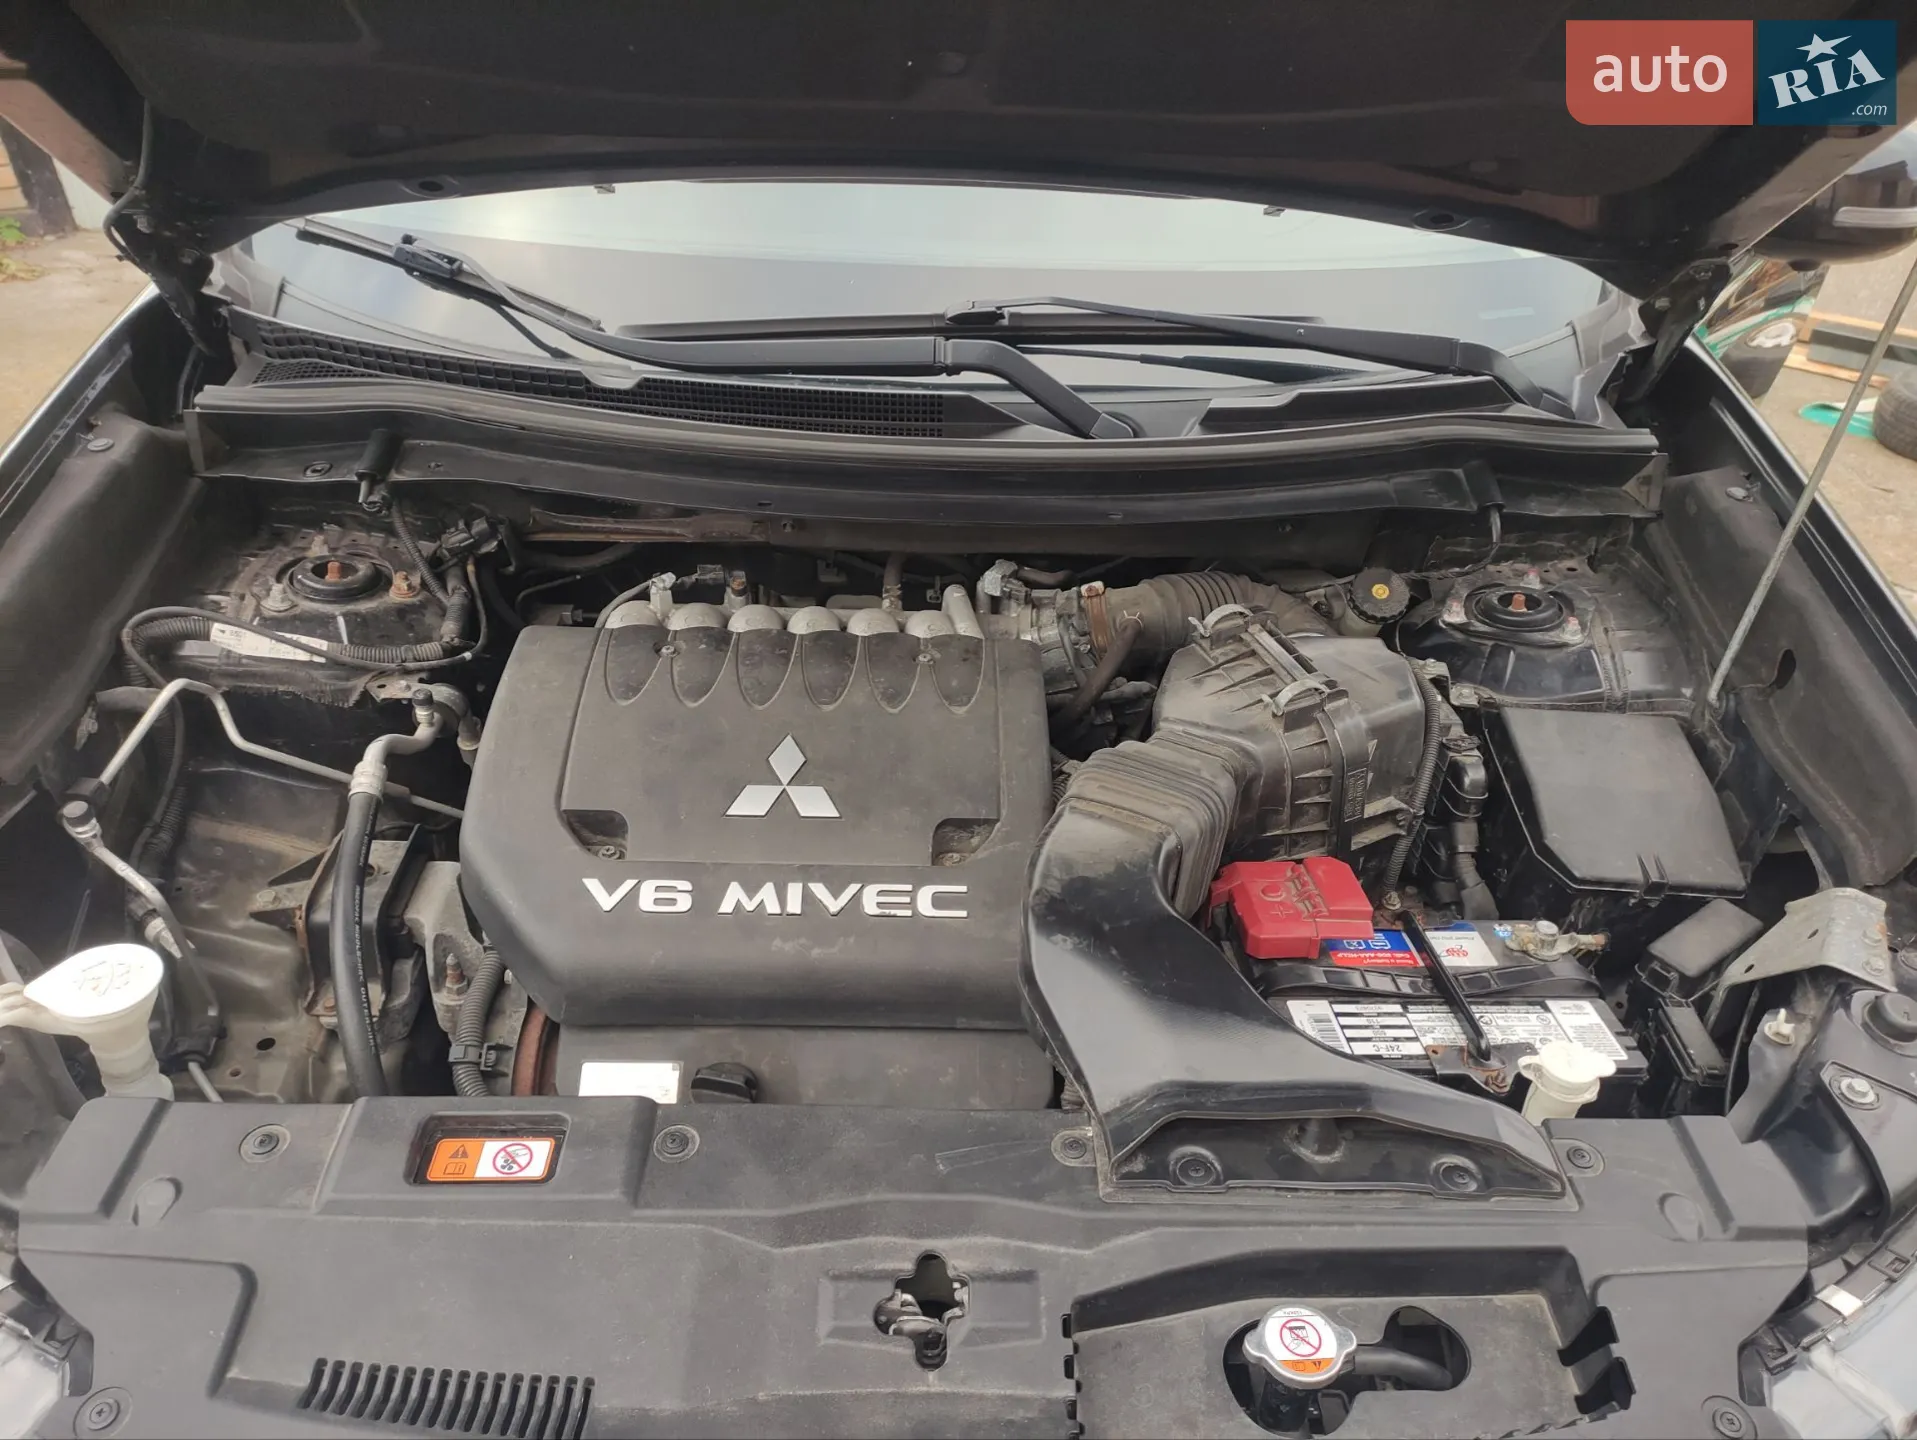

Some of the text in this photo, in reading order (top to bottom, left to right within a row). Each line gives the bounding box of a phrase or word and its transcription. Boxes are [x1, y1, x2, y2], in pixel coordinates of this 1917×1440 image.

[581, 877, 969, 919] V6 MIVEC
[1372, 1043, 1402, 1053] 24F-C
